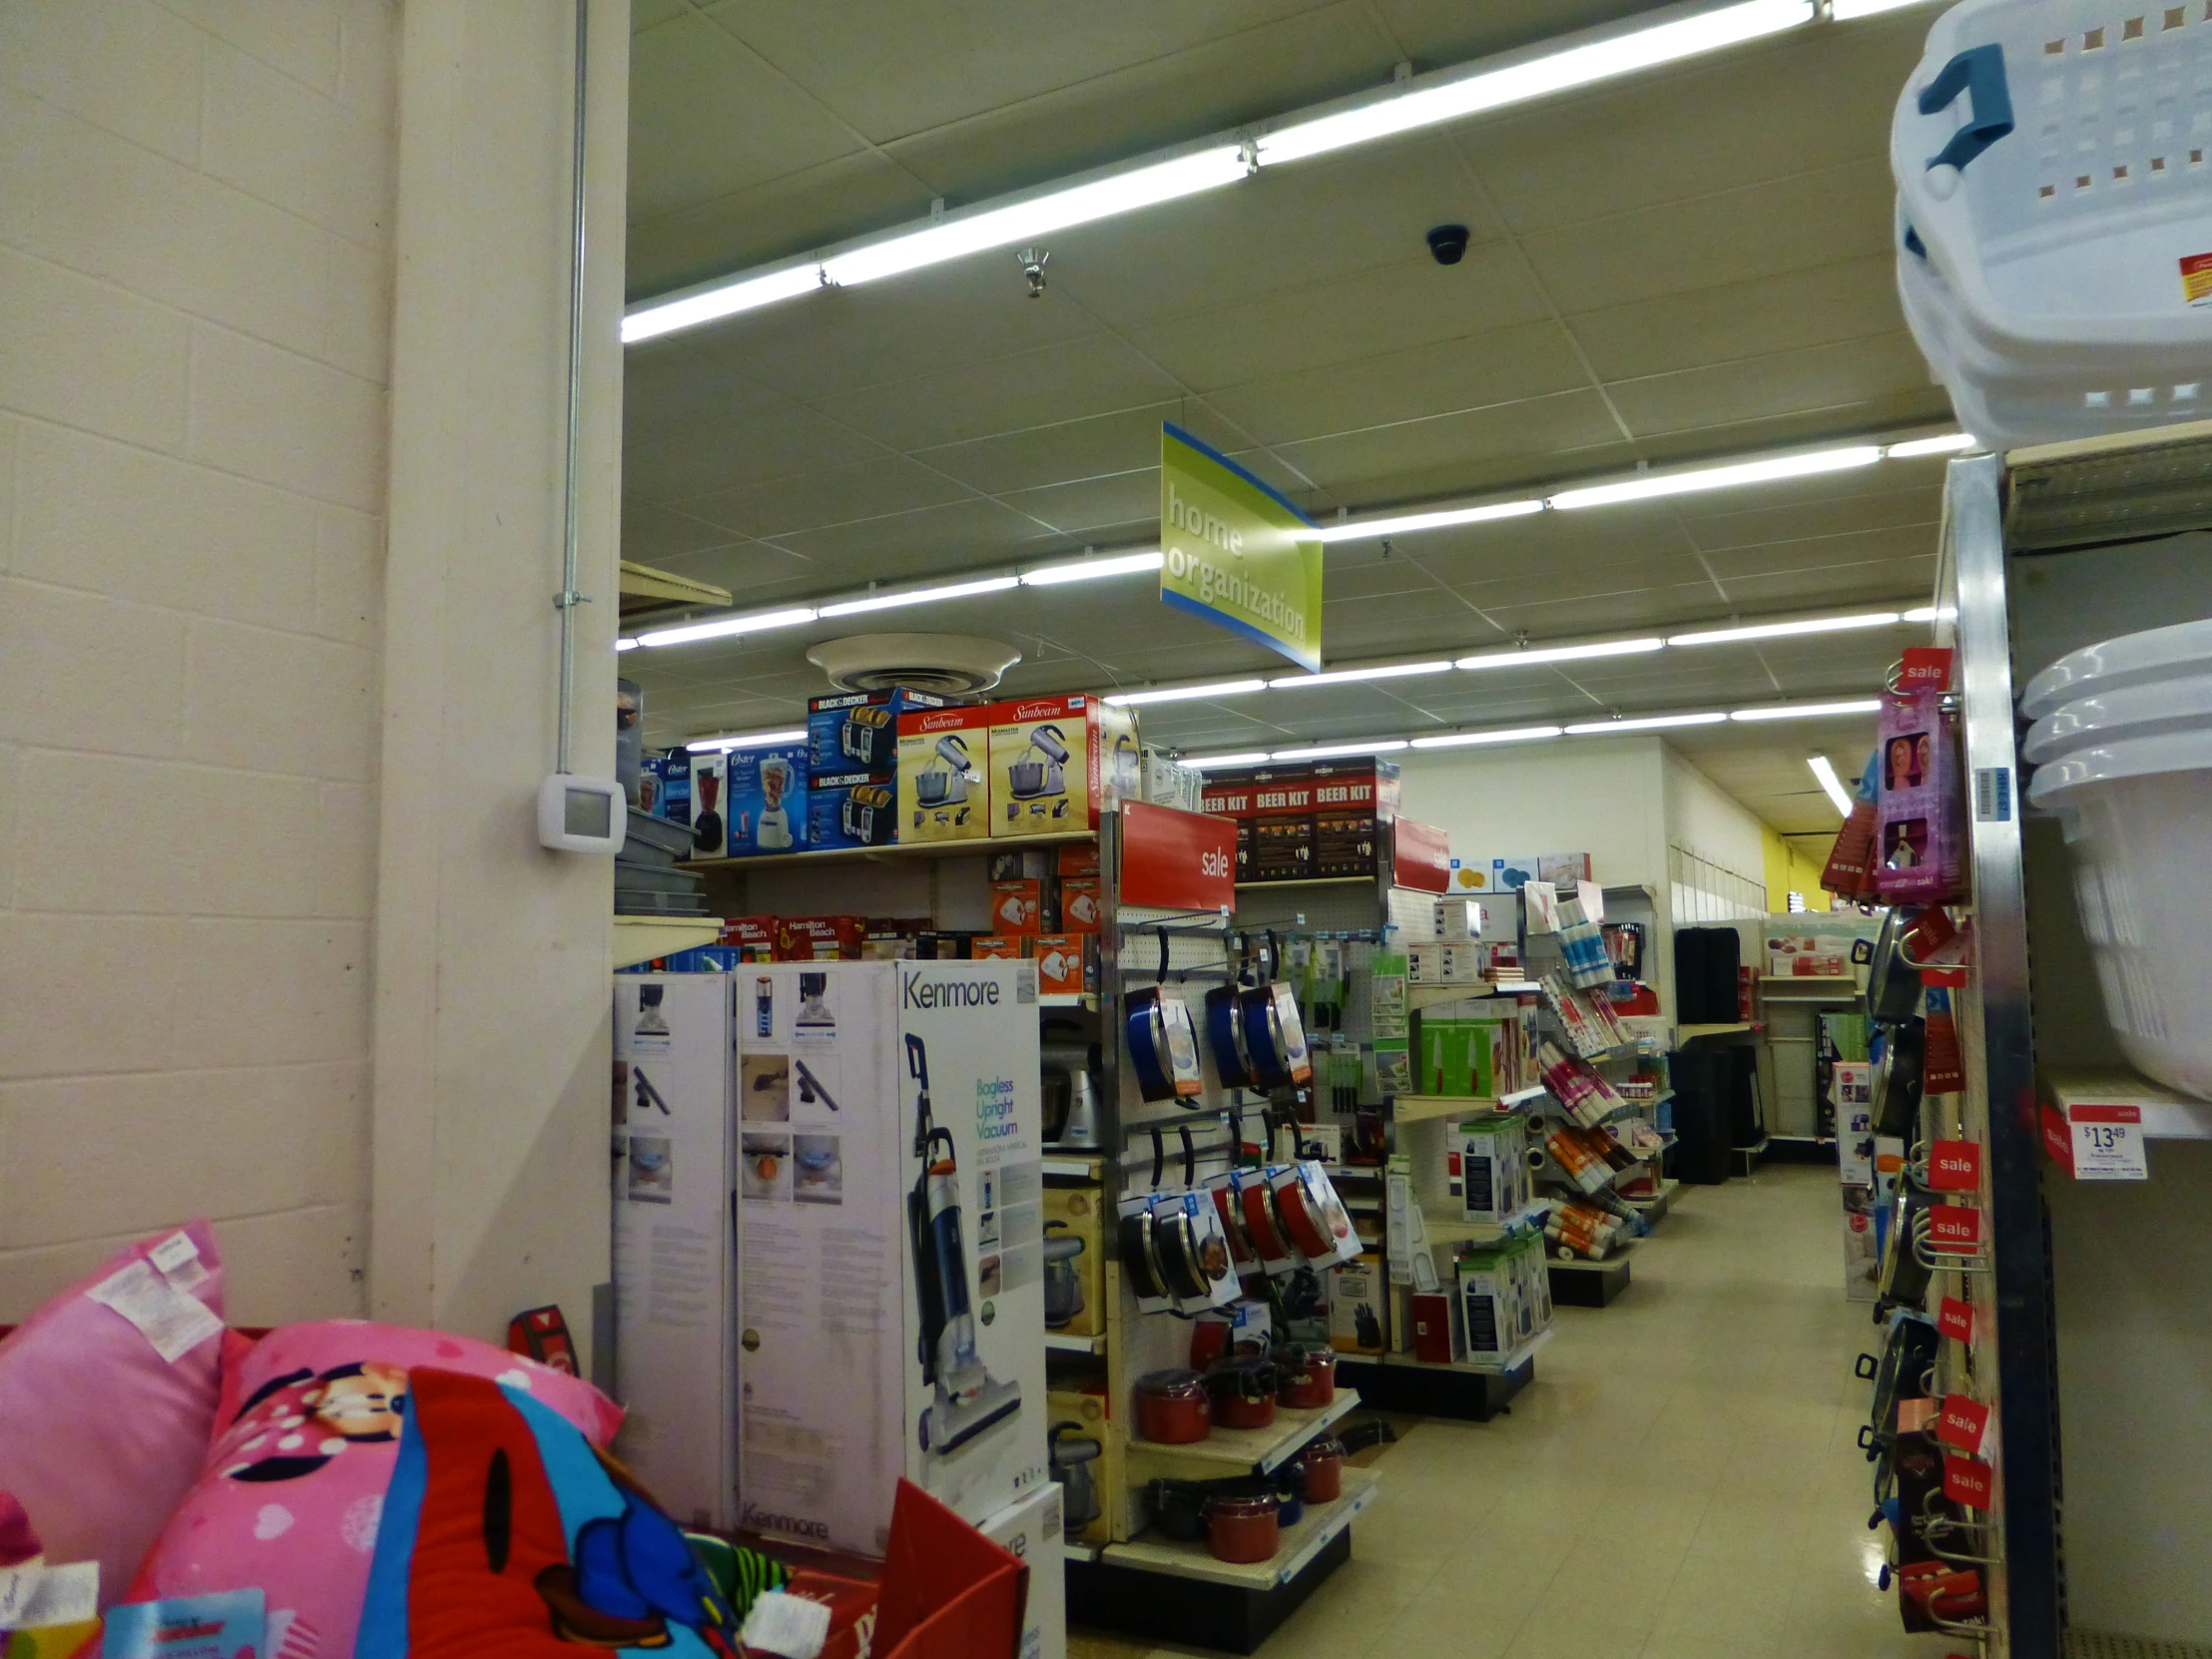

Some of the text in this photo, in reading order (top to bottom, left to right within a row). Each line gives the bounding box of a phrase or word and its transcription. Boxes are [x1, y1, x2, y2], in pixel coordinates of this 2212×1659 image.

[1169, 482, 1243, 559] home
[1168, 546, 1305, 642] organization
[1908, 665, 1941, 679] sale
[819, 695, 868, 710] BLACK&DECKER
[1013, 705, 1061, 723] Sunbeam
[919, 716, 964, 733] Sunbeam
[731, 753, 756, 767] Oster
[1090, 729, 1099, 799] Sunbeam
[668, 764, 689, 776] Oster
[819, 773, 869, 788] BLACK&DECKER
[1228, 796, 1248, 811] KIT
[1257, 791, 1310, 809] BEER KIT
[1317, 786, 1348, 804] BEER
[1350, 785, 1372, 802] KIT
[1202, 845, 1229, 878] sale
[790, 920, 826, 930] Hamilton
[810, 928, 835, 937] Beach
[741, 930, 767, 939] Beach
[903, 970, 999, 1009] Kenmore
[976, 1076, 1014, 1098] Bagless
[976, 1096, 1014, 1121] Upright
[975, 1121, 1018, 1140] Vacuum
[2046, 1128, 2069, 1154] sale
[1939, 1158, 1971, 1172] sale
[1936, 1223, 1970, 1237] sale
[1944, 1313, 1966, 1328] sale
[1947, 1413, 1976, 1433] sale
[1951, 1473, 1983, 1492] sale
[742, 1501, 830, 1539] Kenmore
